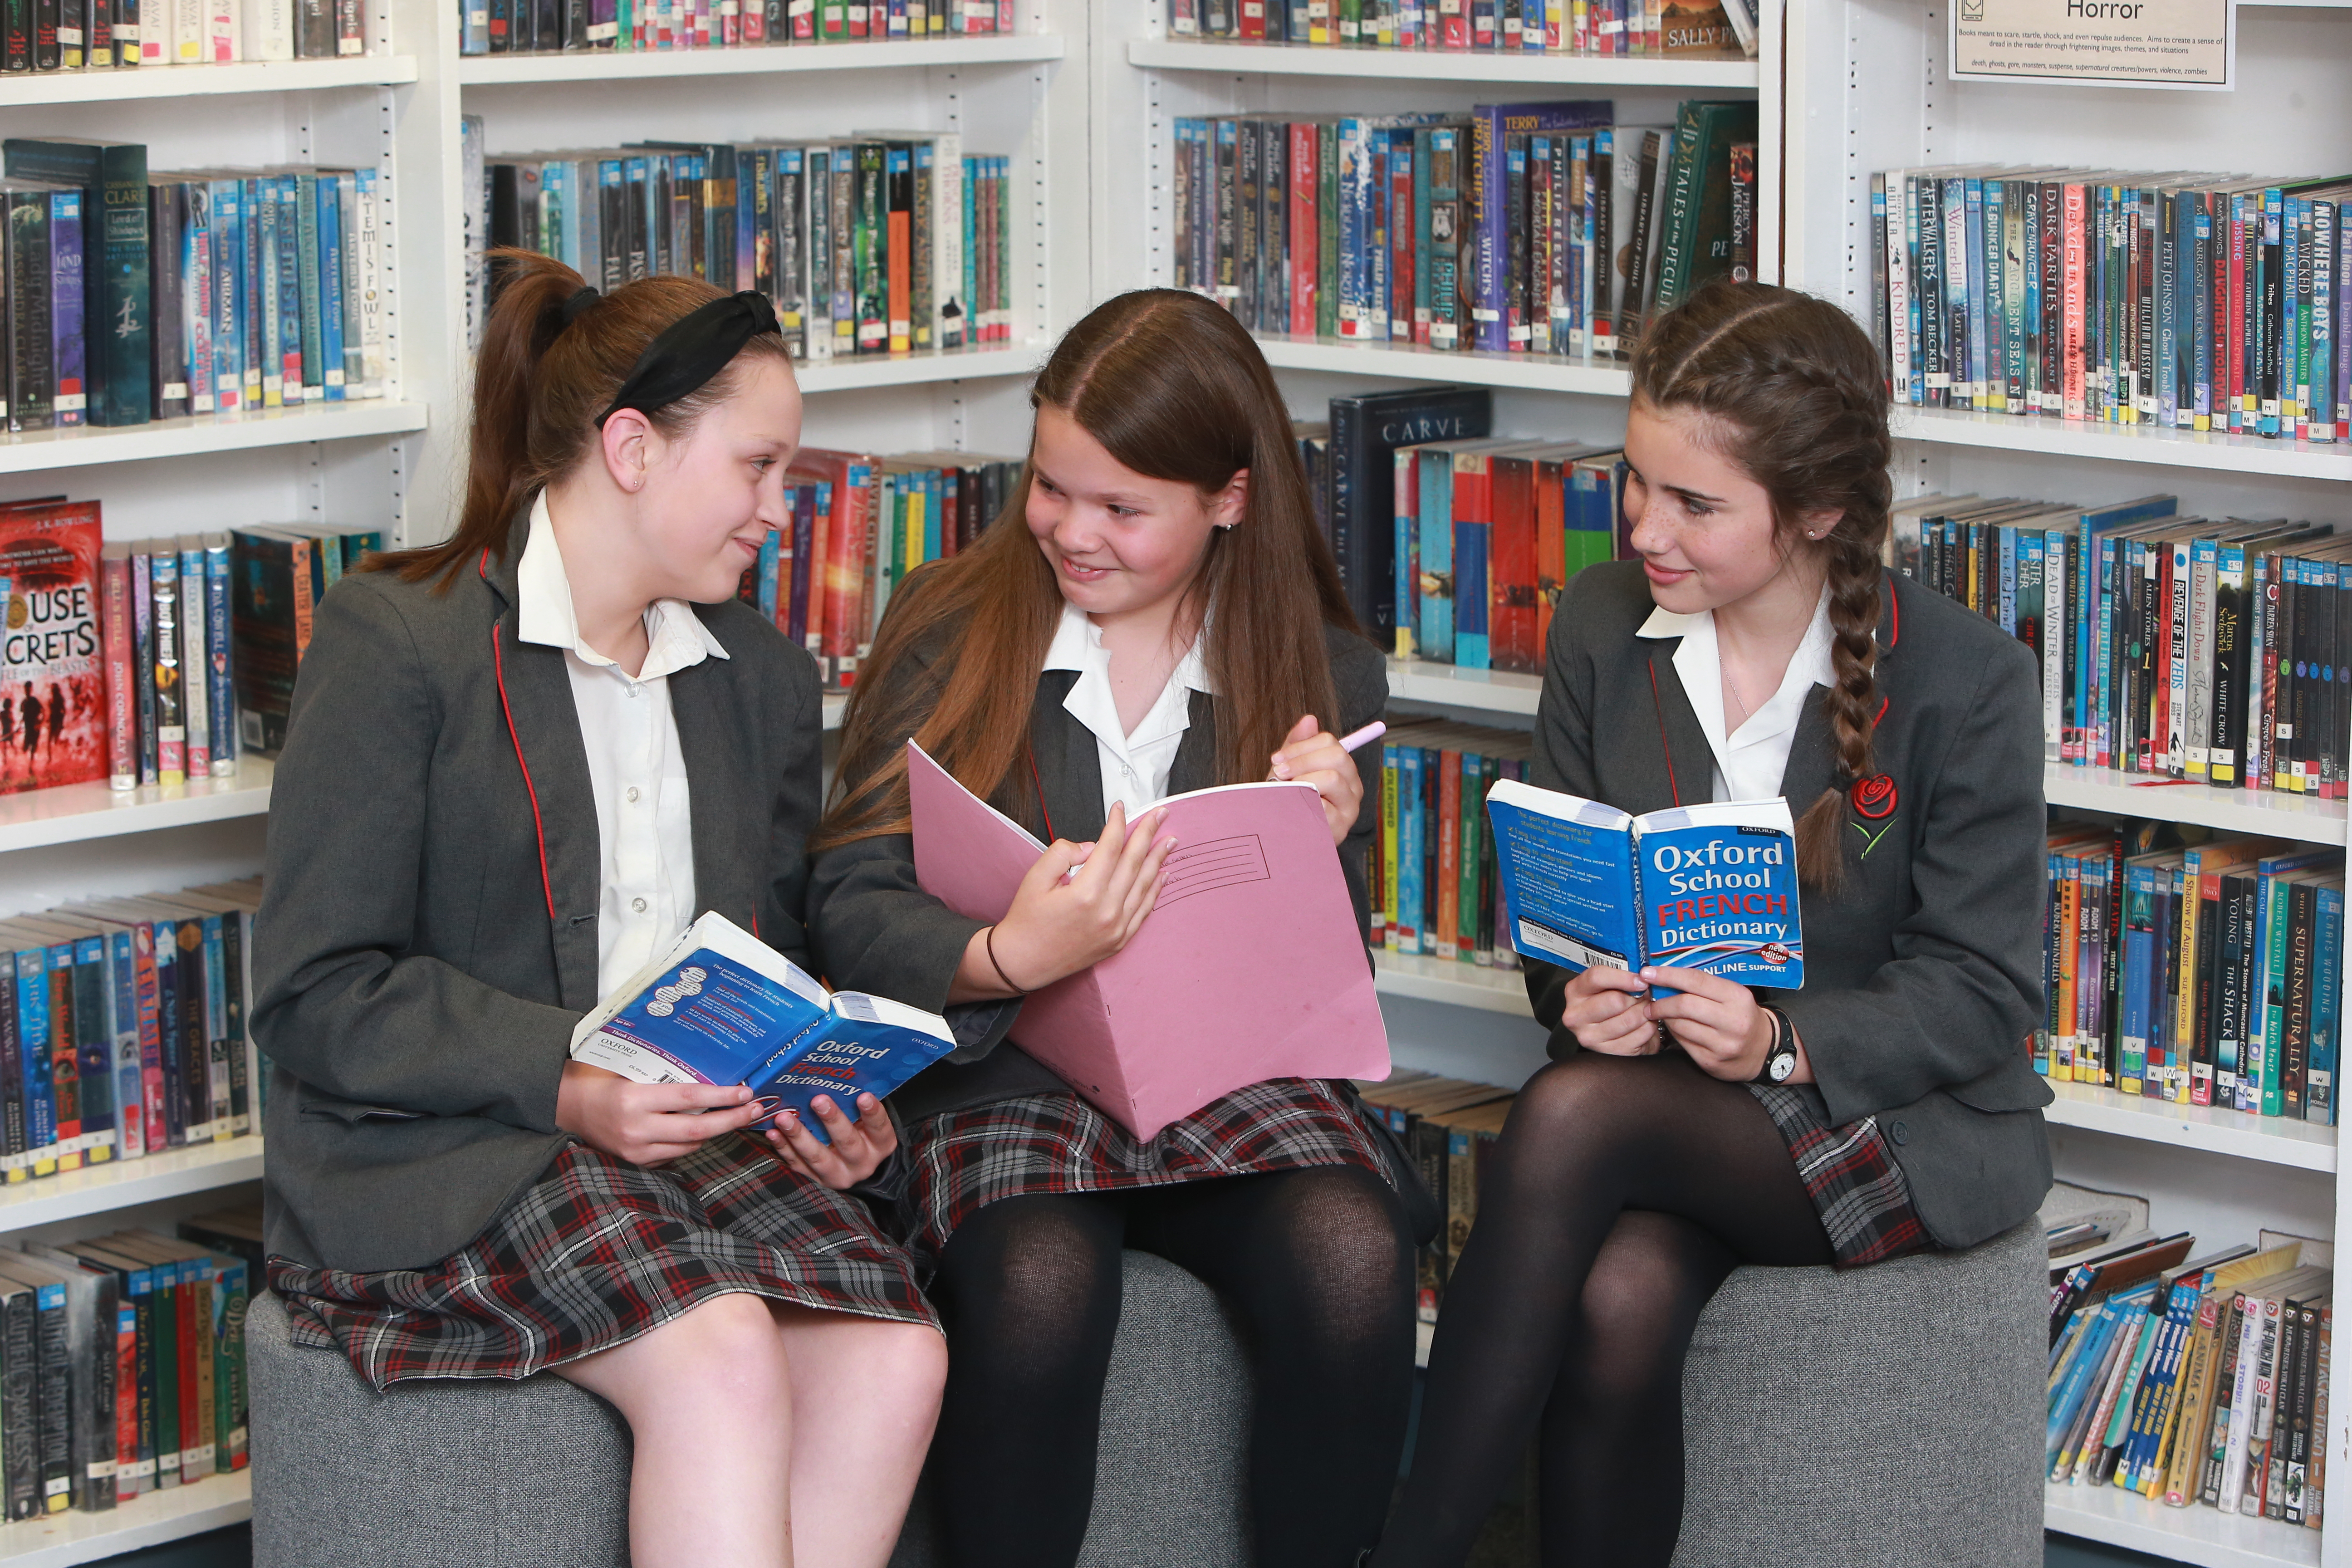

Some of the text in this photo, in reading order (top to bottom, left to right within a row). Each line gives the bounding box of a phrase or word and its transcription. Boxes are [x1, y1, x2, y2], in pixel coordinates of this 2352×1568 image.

[2068, 0, 2143, 19] Horror
[1668, 27, 1716, 47] SALLY
[2045, 43, 2067, 51] through
[2069, 43, 2100, 52] frightening
[2102, 44, 2122, 53] images,
[1989, 60, 2005, 68] ghosts,
[2111, 65, 2158, 74] creatures/powers,
[1504, 116, 1540, 130] TERRY
[1553, 147, 1562, 211] PHILIP
[1673, 167, 1690, 218] TALES
[105, 190, 147, 204] CLARE
[1731, 175, 1745, 245] JACKSON
[1887, 186, 1897, 234] BUTLER
[1921, 187, 1937, 279] AFTERWALKERS
[1948, 206, 1963, 285] Winterkill
[2046, 190, 2057, 311] DARK PARTIES
[2342, 231, 2352, 286] Pat Moon
[2161, 241, 2172, 323] PETE JOHNSON
[2298, 242, 2310, 294] WICKED
[2313, 206, 2330, 340] NOWHERE BOYS
[220, 268, 232, 333] AIRMAN
[1891, 282, 1906, 363] KINDRED
[1927, 292, 1937, 372] TOM BECKER
[2141, 297, 2151, 379] WILLIAM HUSSEY
[1382, 416, 1465, 442] CARVE
[2048, 555, 2059, 594] DEAD
[2195, 574, 2206, 598] Dark
[2046, 605, 2060, 658] WINTER
[2192, 601, 2205, 630] Flight
[2217, 608, 2228, 653] Sedgwick
[6, 620, 94, 665] CRETS
[2171, 581, 2185, 690] REVENGE OF THE ZEDS
[2194, 634, 2205, 661] Down
[2226, 614, 2237, 651] Marcus
[2219, 680, 2227, 712] WHITE
[1518, 810, 1527, 818] The
[1529, 816, 1549, 825] perfect
[1552, 822, 1581, 836] dictionary
[1521, 820, 1591, 844] students learning French
[1654, 840, 1783, 872] Oxford
[1669, 868, 1770, 896] School
[2111, 840, 2122, 937] DREADFUL FATES
[1658, 894, 1787, 926] FRENCH
[2181, 880, 2194, 967] Shadow of August
[2228, 897, 2239, 944] YOUNG
[1524, 925, 1553, 940] OXFORD
[1661, 921, 1788, 947] Dictionary
[1768, 944, 1784, 952] new
[1700, 963, 1786, 975] NLINE SUPPORT
[1761, 950, 1787, 961] edition
[719, 972, 747, 986] beginning
[750, 987, 762, 997] learn
[762, 993, 780, 1006] French
[722, 968, 740, 979] perfect
[740, 976, 765, 991] dictionary
[772, 993, 794, 1009] students
[2289, 926, 2306, 1077] SUPERNATURALLY
[2223, 988, 2235, 1038] SHACK
[2240, 1004, 2249, 1040] Muncaster
[598, 1043, 621, 1054] UNIVERSITY
[601, 1038, 637, 1055] OXFORD
[612, 1029, 697, 1078] Think Dictionaries. Think Oxford.
[802, 1052, 860, 1066] School
[816, 1040, 890, 1059] Oxford
[911, 1038, 938, 1050] OXFORD
[629, 1064, 642, 1073] £6.99
[775, 1074, 861, 1096] Dictionary
[789, 1063, 856, 1080] French
[2310, 1099, 2328, 1107] HORROR
[2257, 1379, 2270, 1394] 02
[2312, 1340, 2330, 1456] ATTACK TITAN
